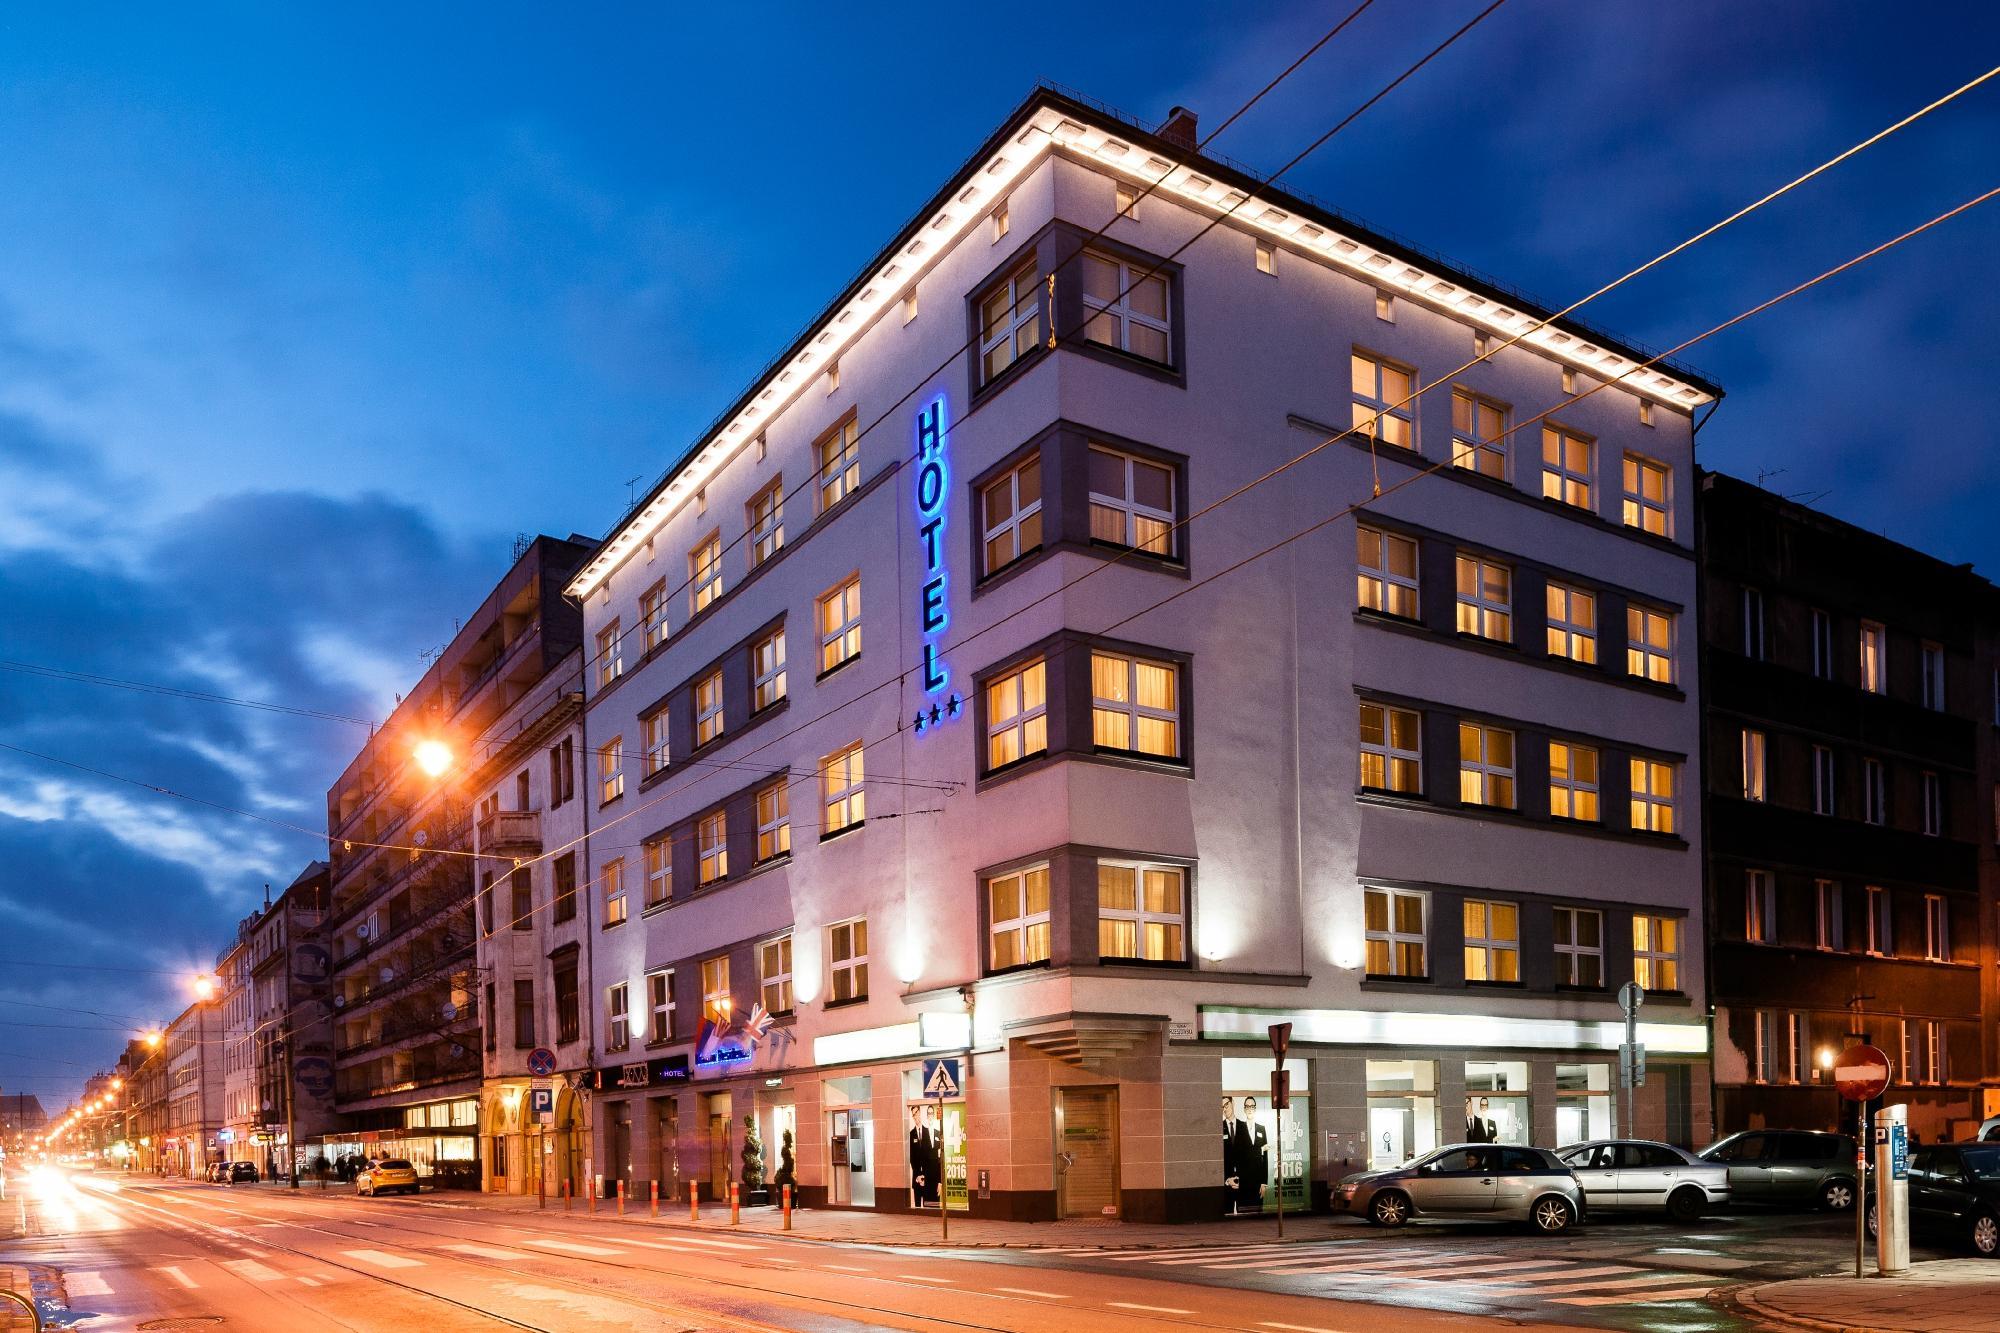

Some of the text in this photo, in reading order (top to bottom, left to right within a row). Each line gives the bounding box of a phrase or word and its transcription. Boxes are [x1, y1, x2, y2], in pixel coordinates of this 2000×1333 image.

[917, 399, 947, 693] HOTEL
[535, 1091, 549, 1110] P
[1875, 1128, 1886, 1144] P
[946, 1164, 967, 1178] 2016
[1273, 1161, 1303, 1178] 2016
